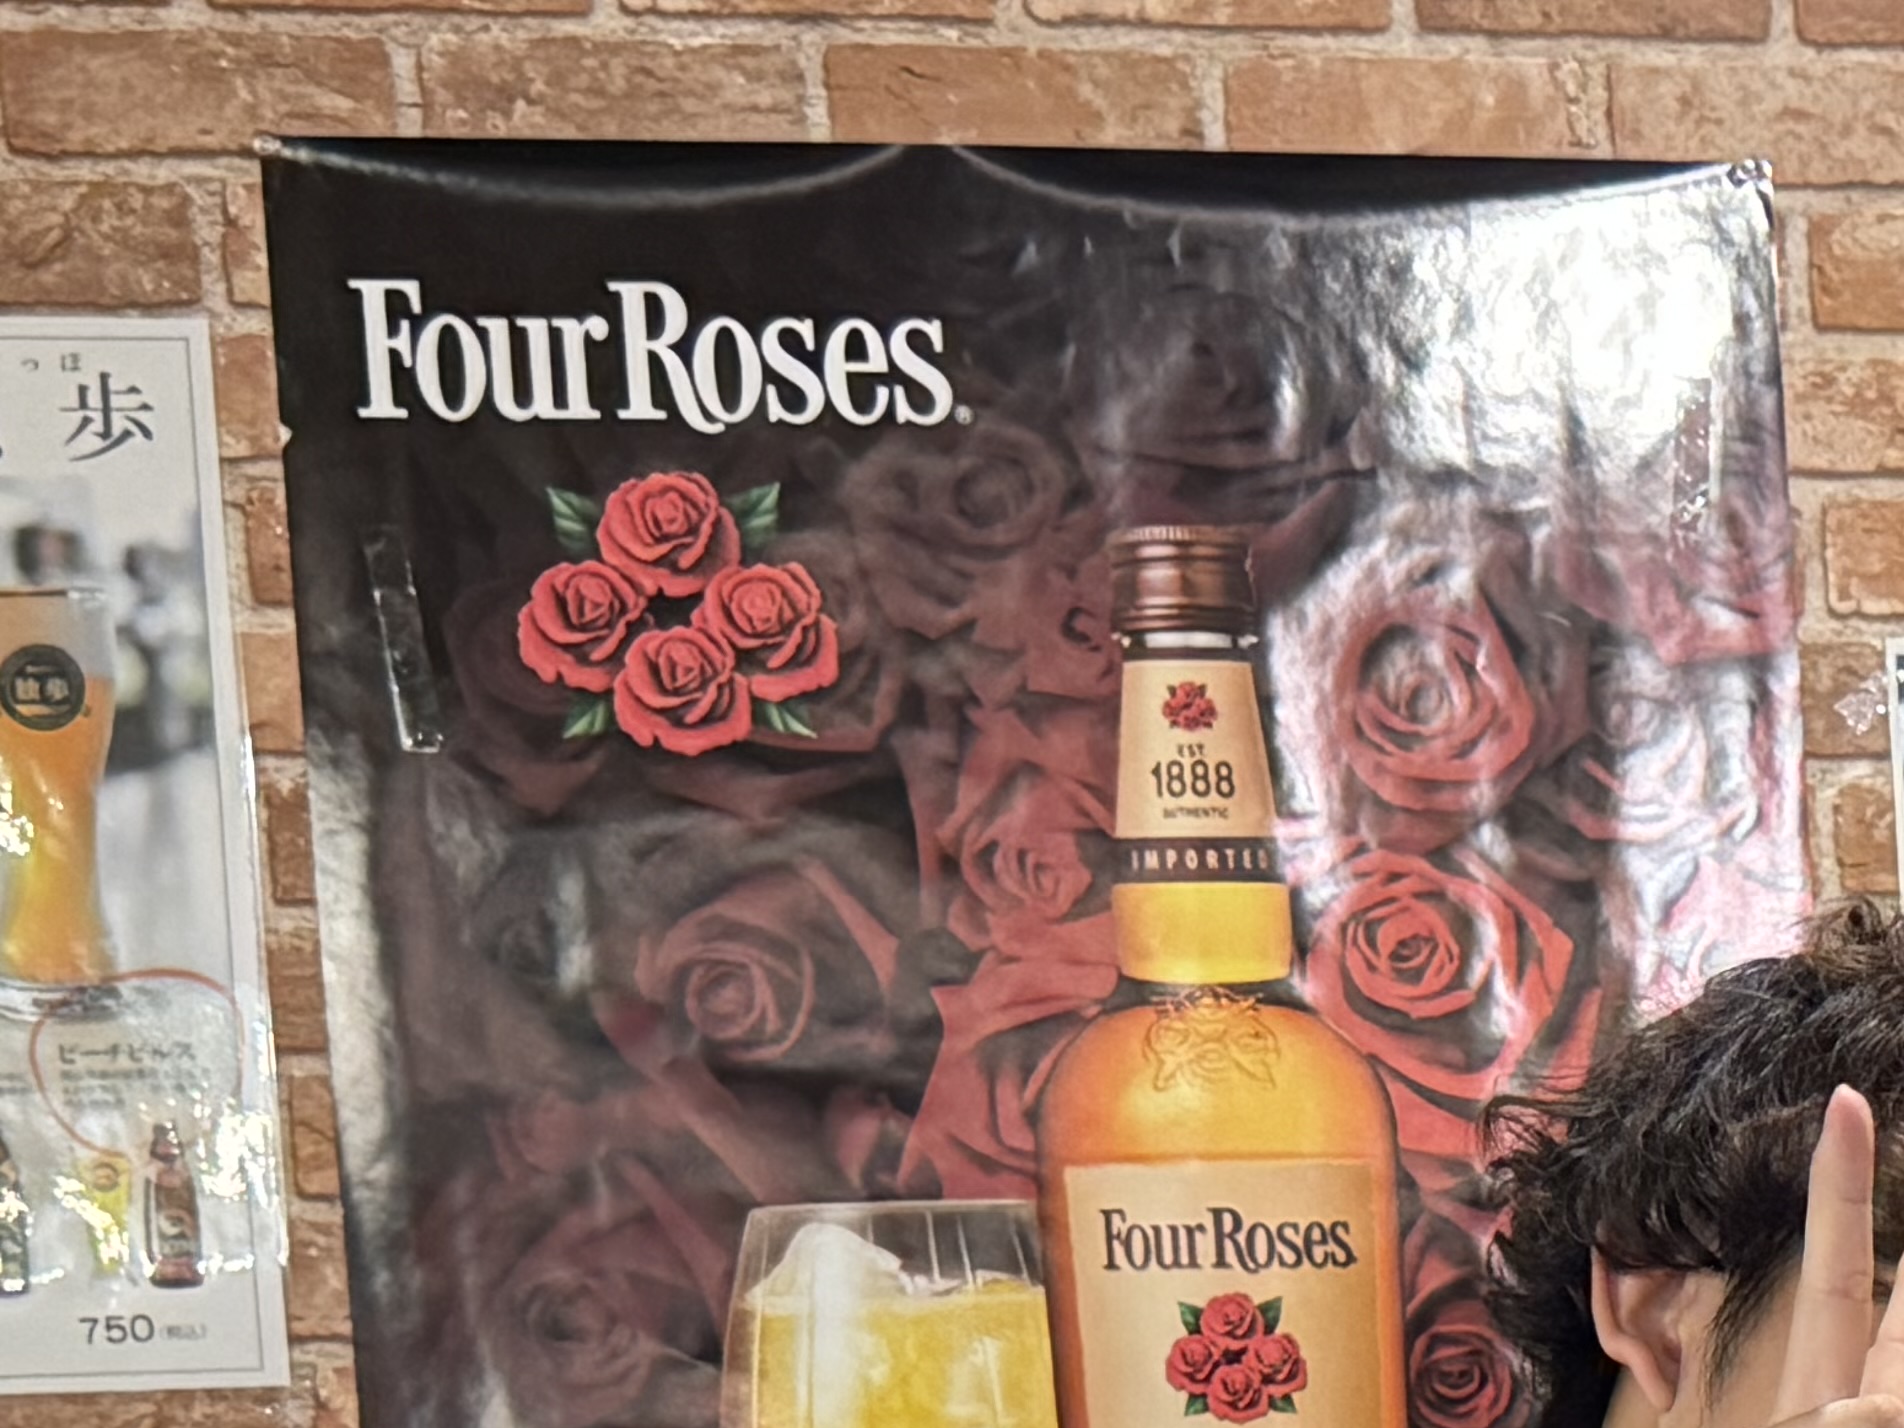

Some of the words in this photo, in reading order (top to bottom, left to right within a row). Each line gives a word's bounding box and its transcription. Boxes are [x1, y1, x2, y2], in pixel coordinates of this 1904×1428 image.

[347, 278, 610, 425] Four
[608, 278, 953, 433] Roses
[59, 370, 154, 462] 歩
[1150, 760, 1236, 799] 1888
[1130, 847, 1270, 872] IMPORTED
[1099, 1207, 1207, 1272] Four
[1206, 1206, 1358, 1274] Roses
[78, 1314, 155, 1345] 750
